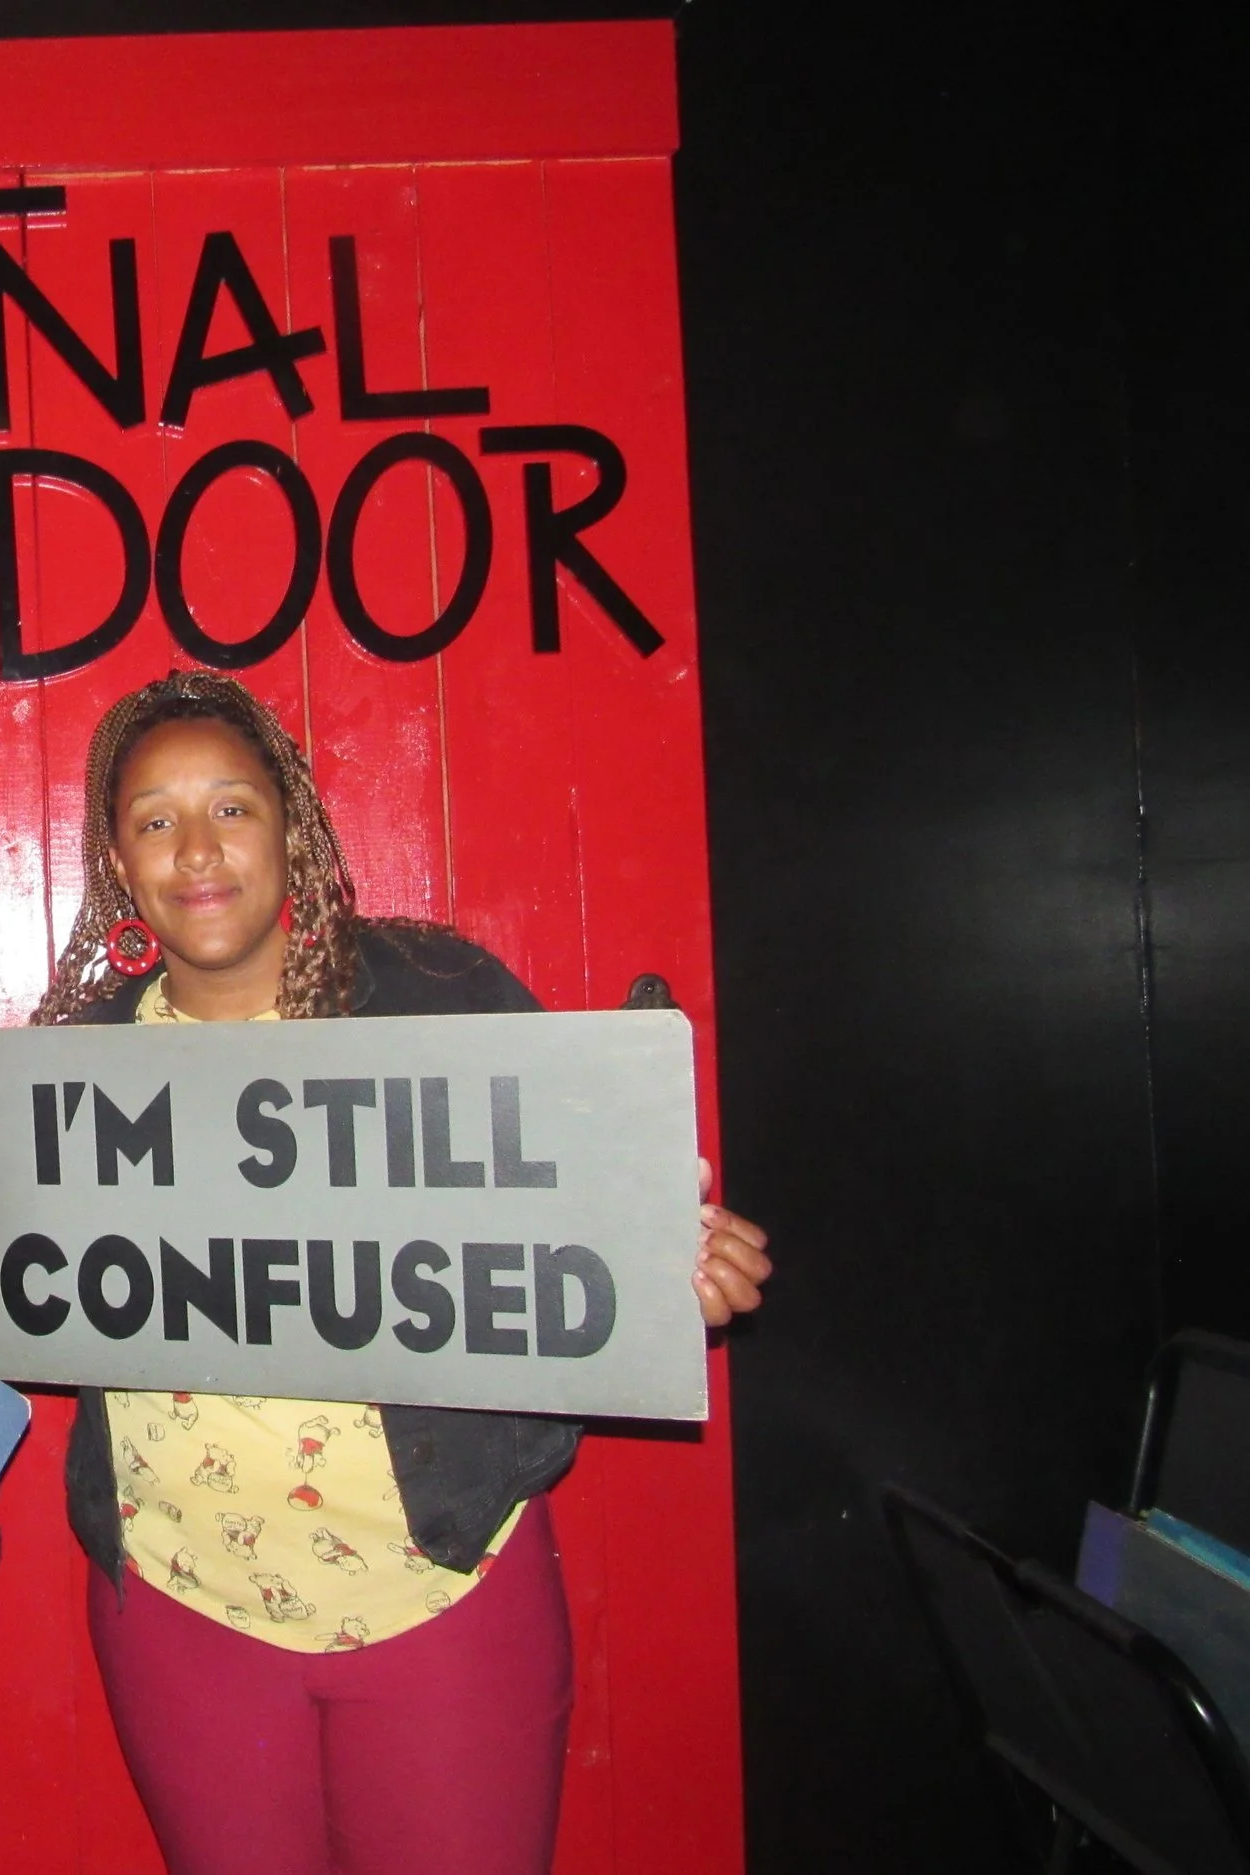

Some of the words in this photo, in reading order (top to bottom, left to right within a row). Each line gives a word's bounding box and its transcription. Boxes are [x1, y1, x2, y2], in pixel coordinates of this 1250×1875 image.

[31, 1080, 175, 1187] I'M
[236, 1076, 558, 1189] STILL
[0, 1232, 617, 1359] CONFUSED
